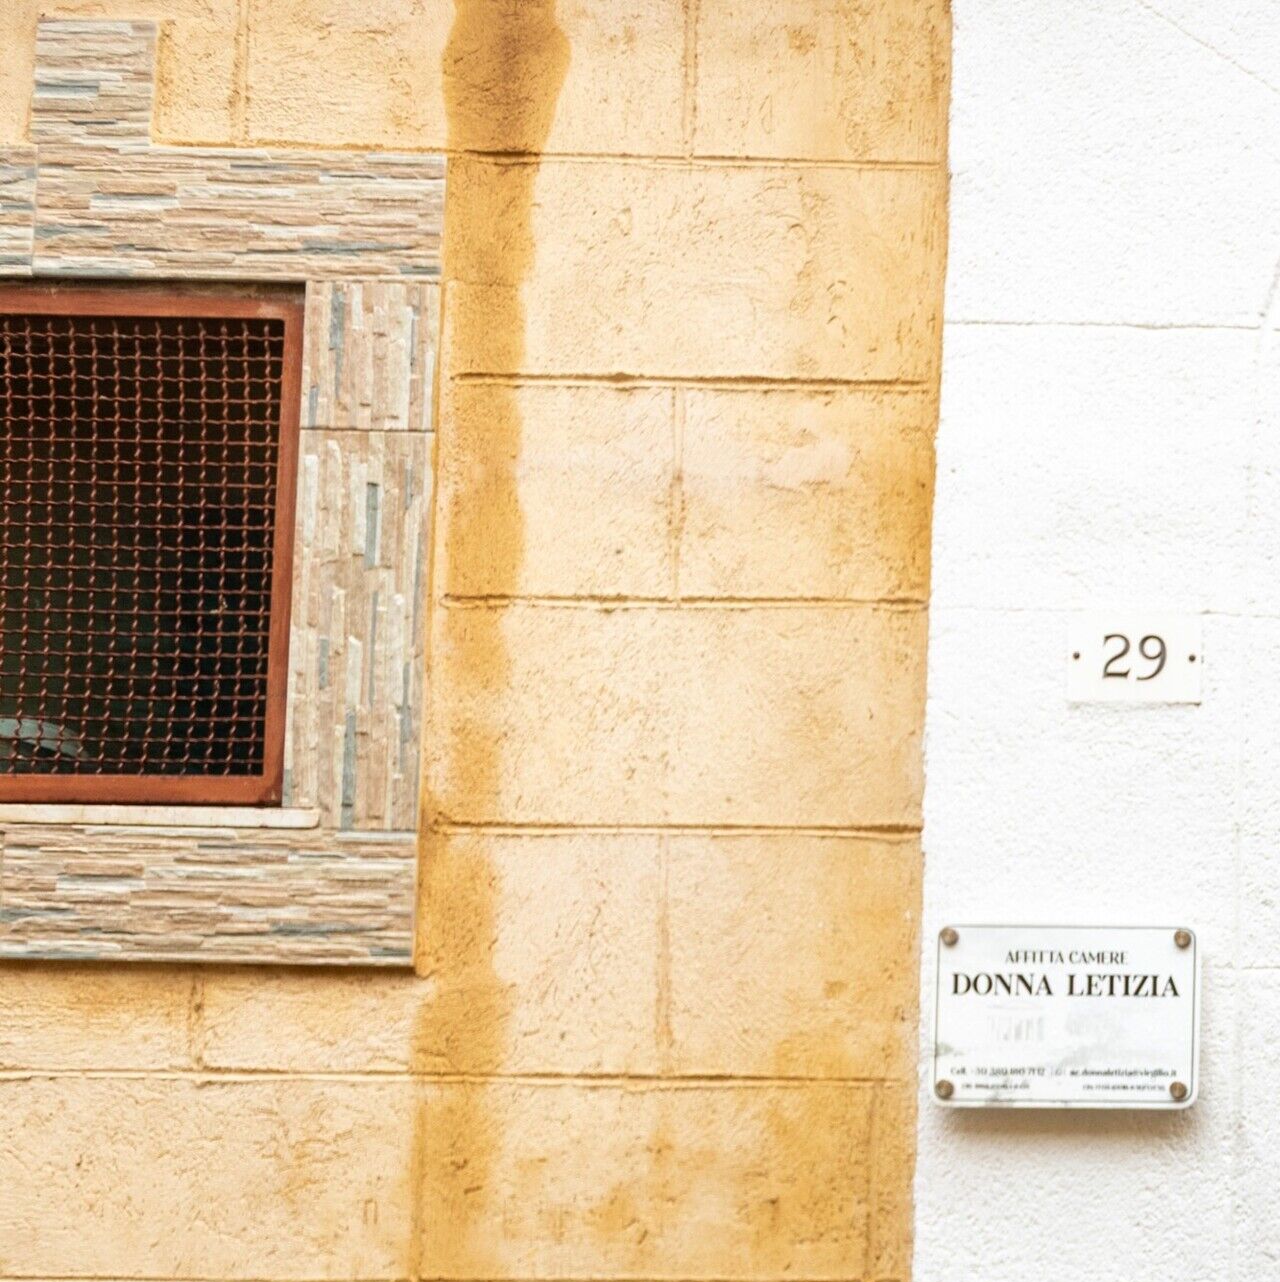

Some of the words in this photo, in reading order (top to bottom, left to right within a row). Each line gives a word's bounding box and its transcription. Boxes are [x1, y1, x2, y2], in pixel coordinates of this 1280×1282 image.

[1102, 633, 1167, 681] 29
[1005, 950, 1065, 964] AFFITTA
[1069, 951, 1128, 965] CAMERE
[952, 972, 1054, 997] DONNA
[1067, 973, 1180, 998] LETIZIA
